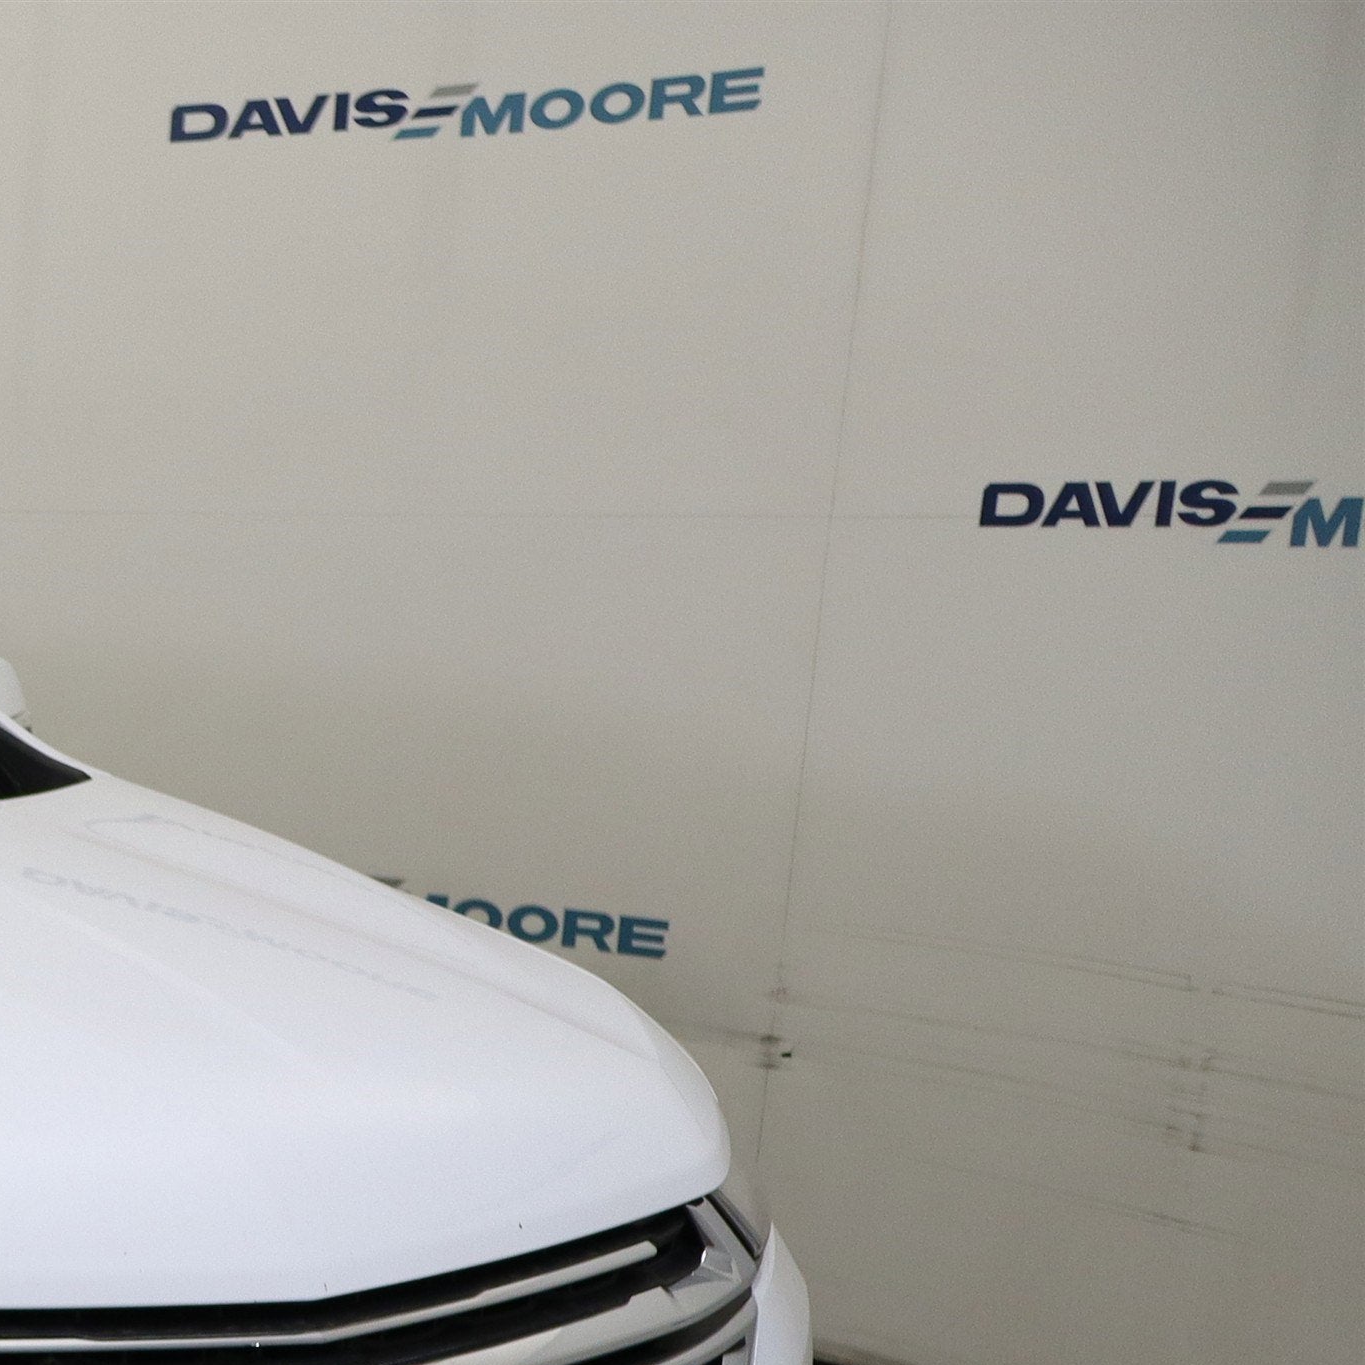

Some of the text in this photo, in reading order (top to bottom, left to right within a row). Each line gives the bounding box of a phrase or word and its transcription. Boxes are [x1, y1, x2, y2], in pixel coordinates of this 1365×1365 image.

[170, 67, 764, 142] DAVIS MOORE
[979, 480, 1239, 528] DAVIS
[427, 893, 669, 958] OORE
